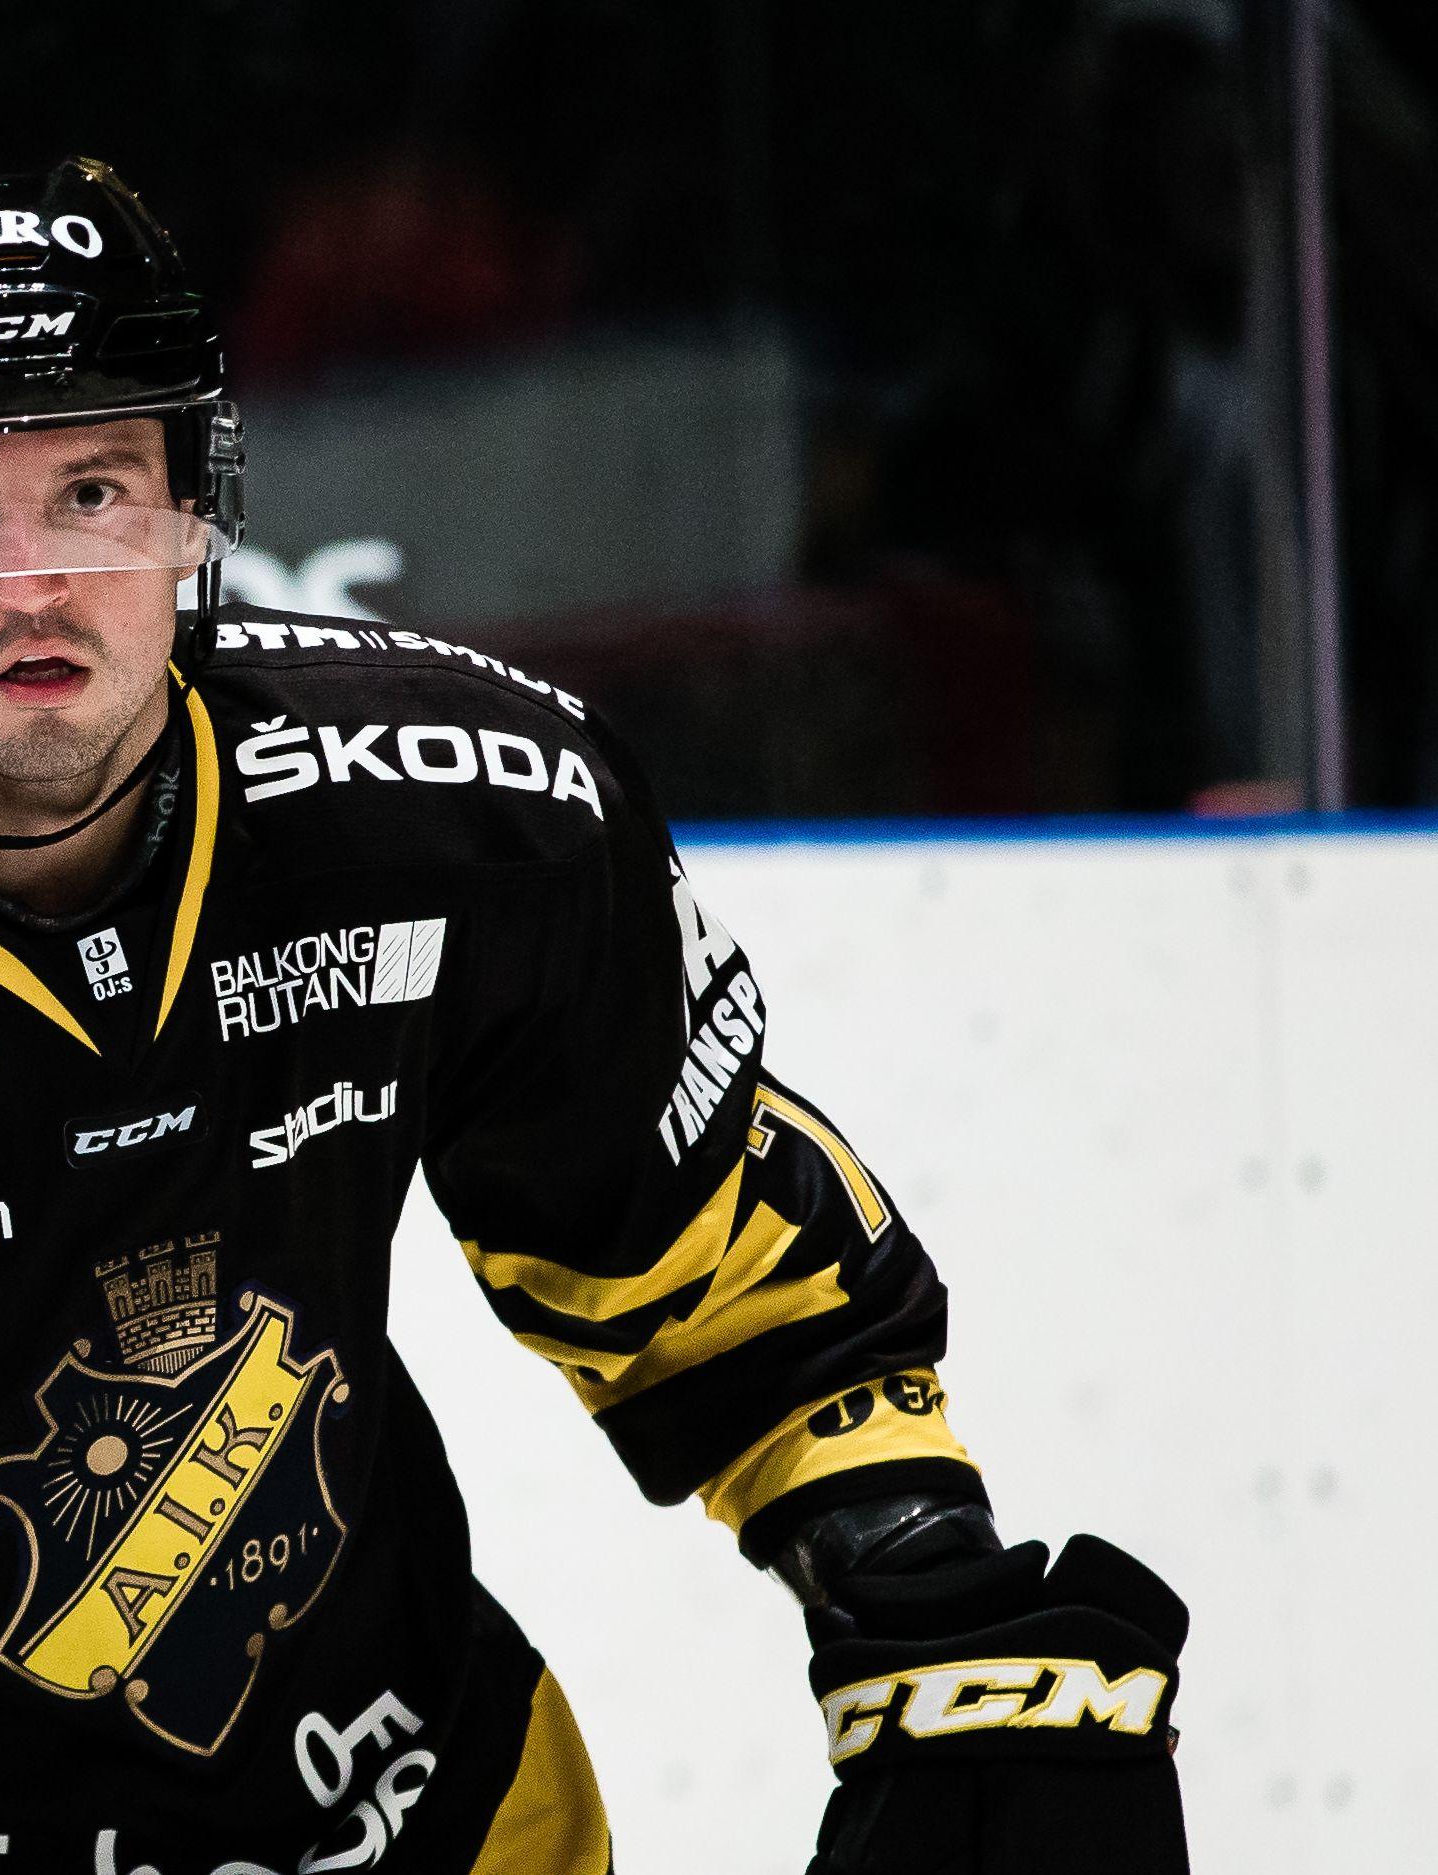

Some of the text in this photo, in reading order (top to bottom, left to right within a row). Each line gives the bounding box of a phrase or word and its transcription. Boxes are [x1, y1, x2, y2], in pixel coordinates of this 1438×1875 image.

[235, 714, 605, 823] ŠKODA
[210, 926, 375, 998] BALKONG
[217, 964, 367, 1042] RUTAN
[72, 1105, 198, 1156] CCM
[819, 1657, 1168, 1767] CCM
